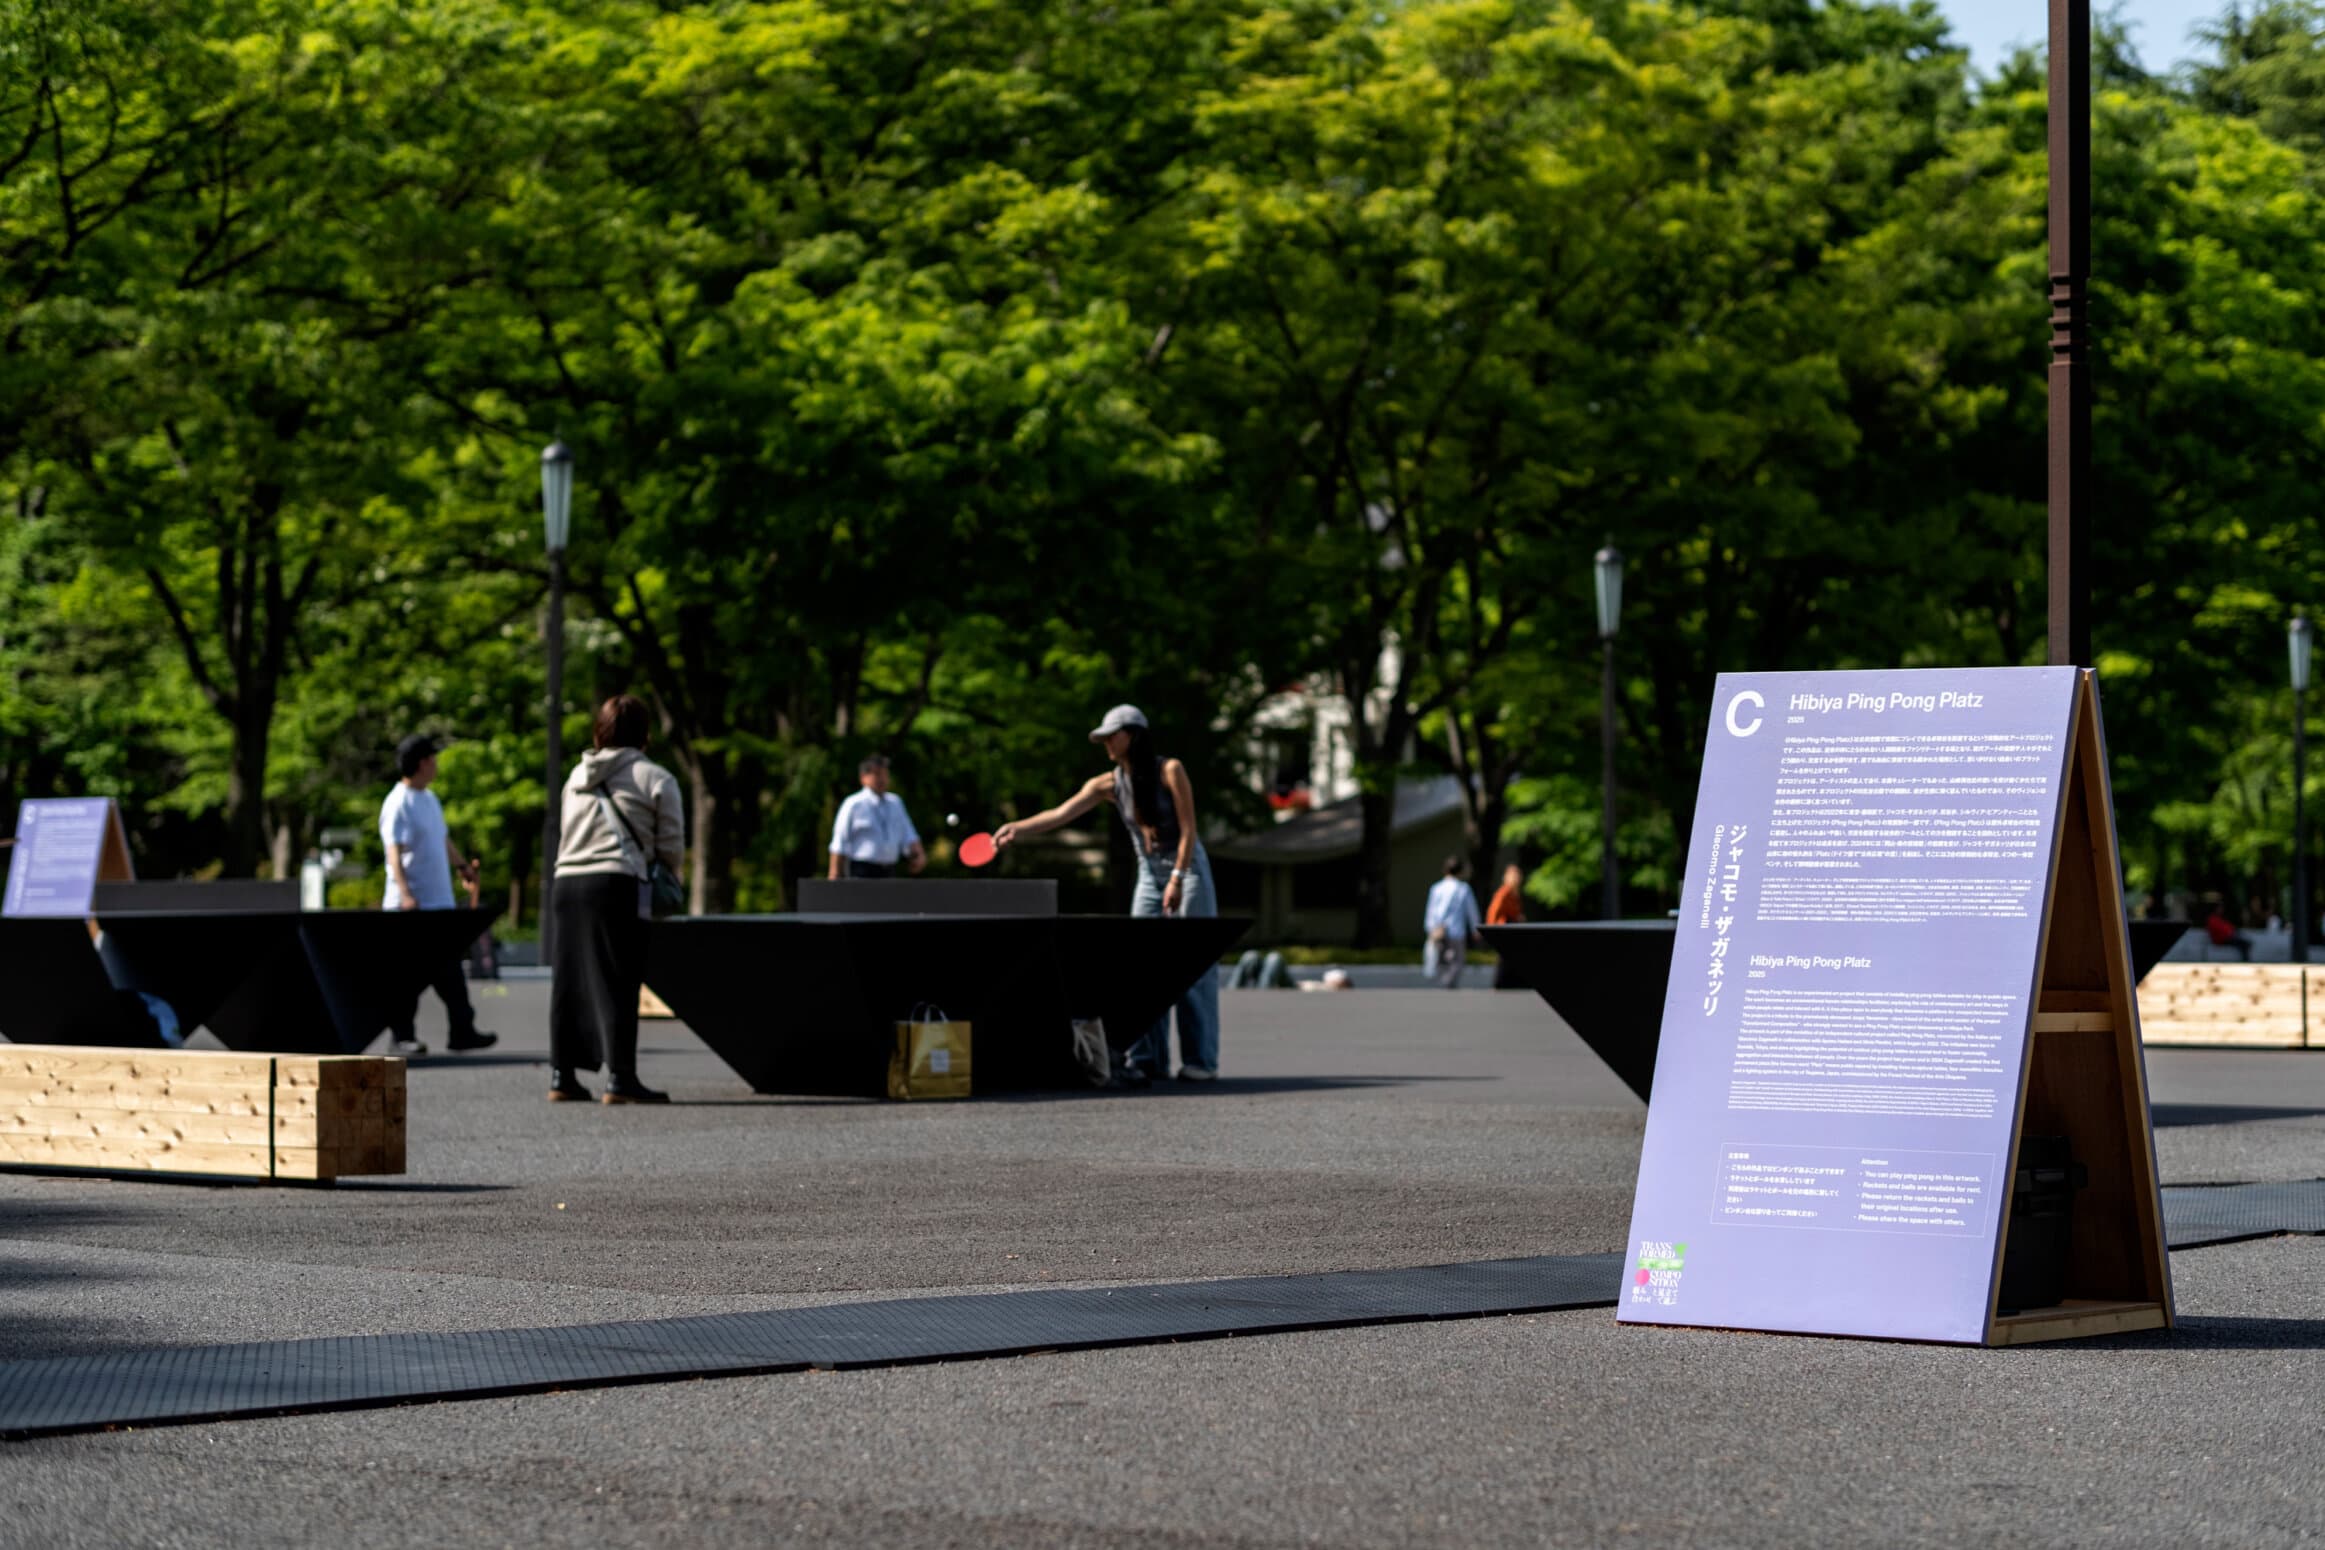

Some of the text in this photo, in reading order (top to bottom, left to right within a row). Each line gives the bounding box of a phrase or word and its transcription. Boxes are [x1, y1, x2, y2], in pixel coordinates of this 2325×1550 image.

[1726, 691, 1764, 737] C
[1790, 692, 1983, 713] Hibiya Ping Pong Platz
[1701, 825, 1724, 928] Giacomo Zaganelli
[1705, 826, 1746, 1015] ジャコモ・ザガネッリ
[1751, 956, 1871, 970] Hibiya Ping Pong Platz
